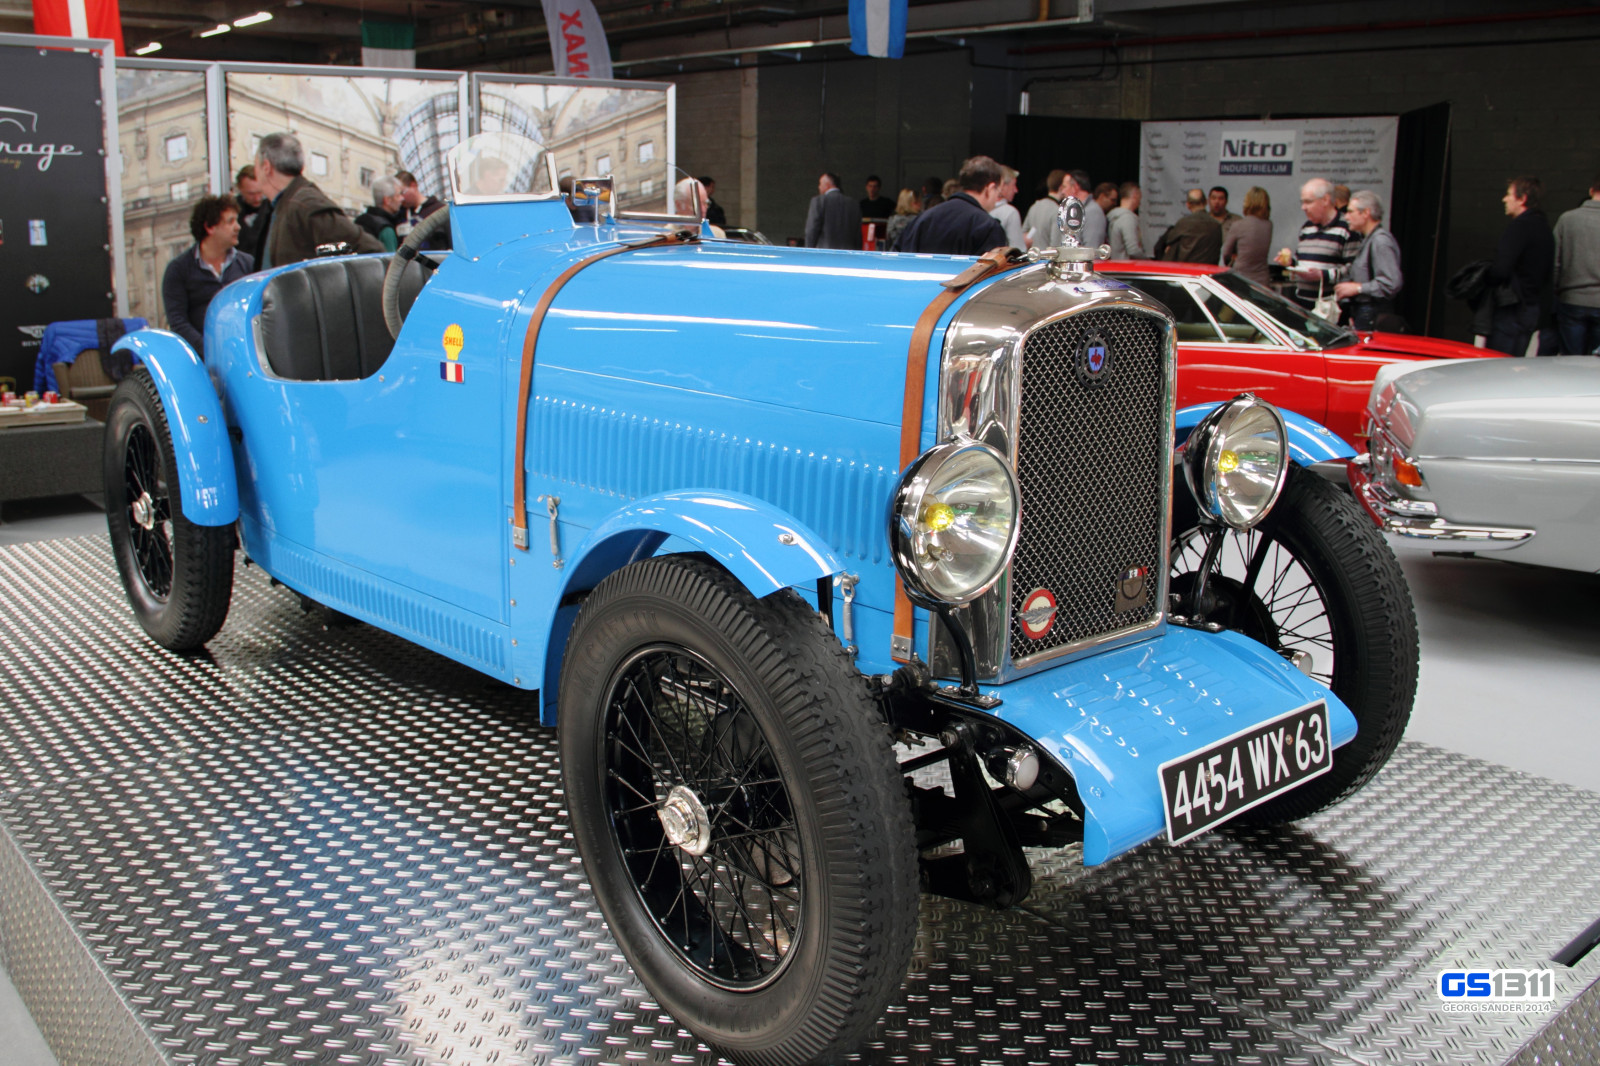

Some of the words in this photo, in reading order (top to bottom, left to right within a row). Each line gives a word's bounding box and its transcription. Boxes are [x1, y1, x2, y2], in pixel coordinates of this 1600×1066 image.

[1223, 139, 1287, 157] Nitro
[444, 336, 463, 347] SHELL
[1173, 746, 1244, 825] 4454
[1248, 727, 1290, 790] WX
[1295, 713, 1325, 771] 63
